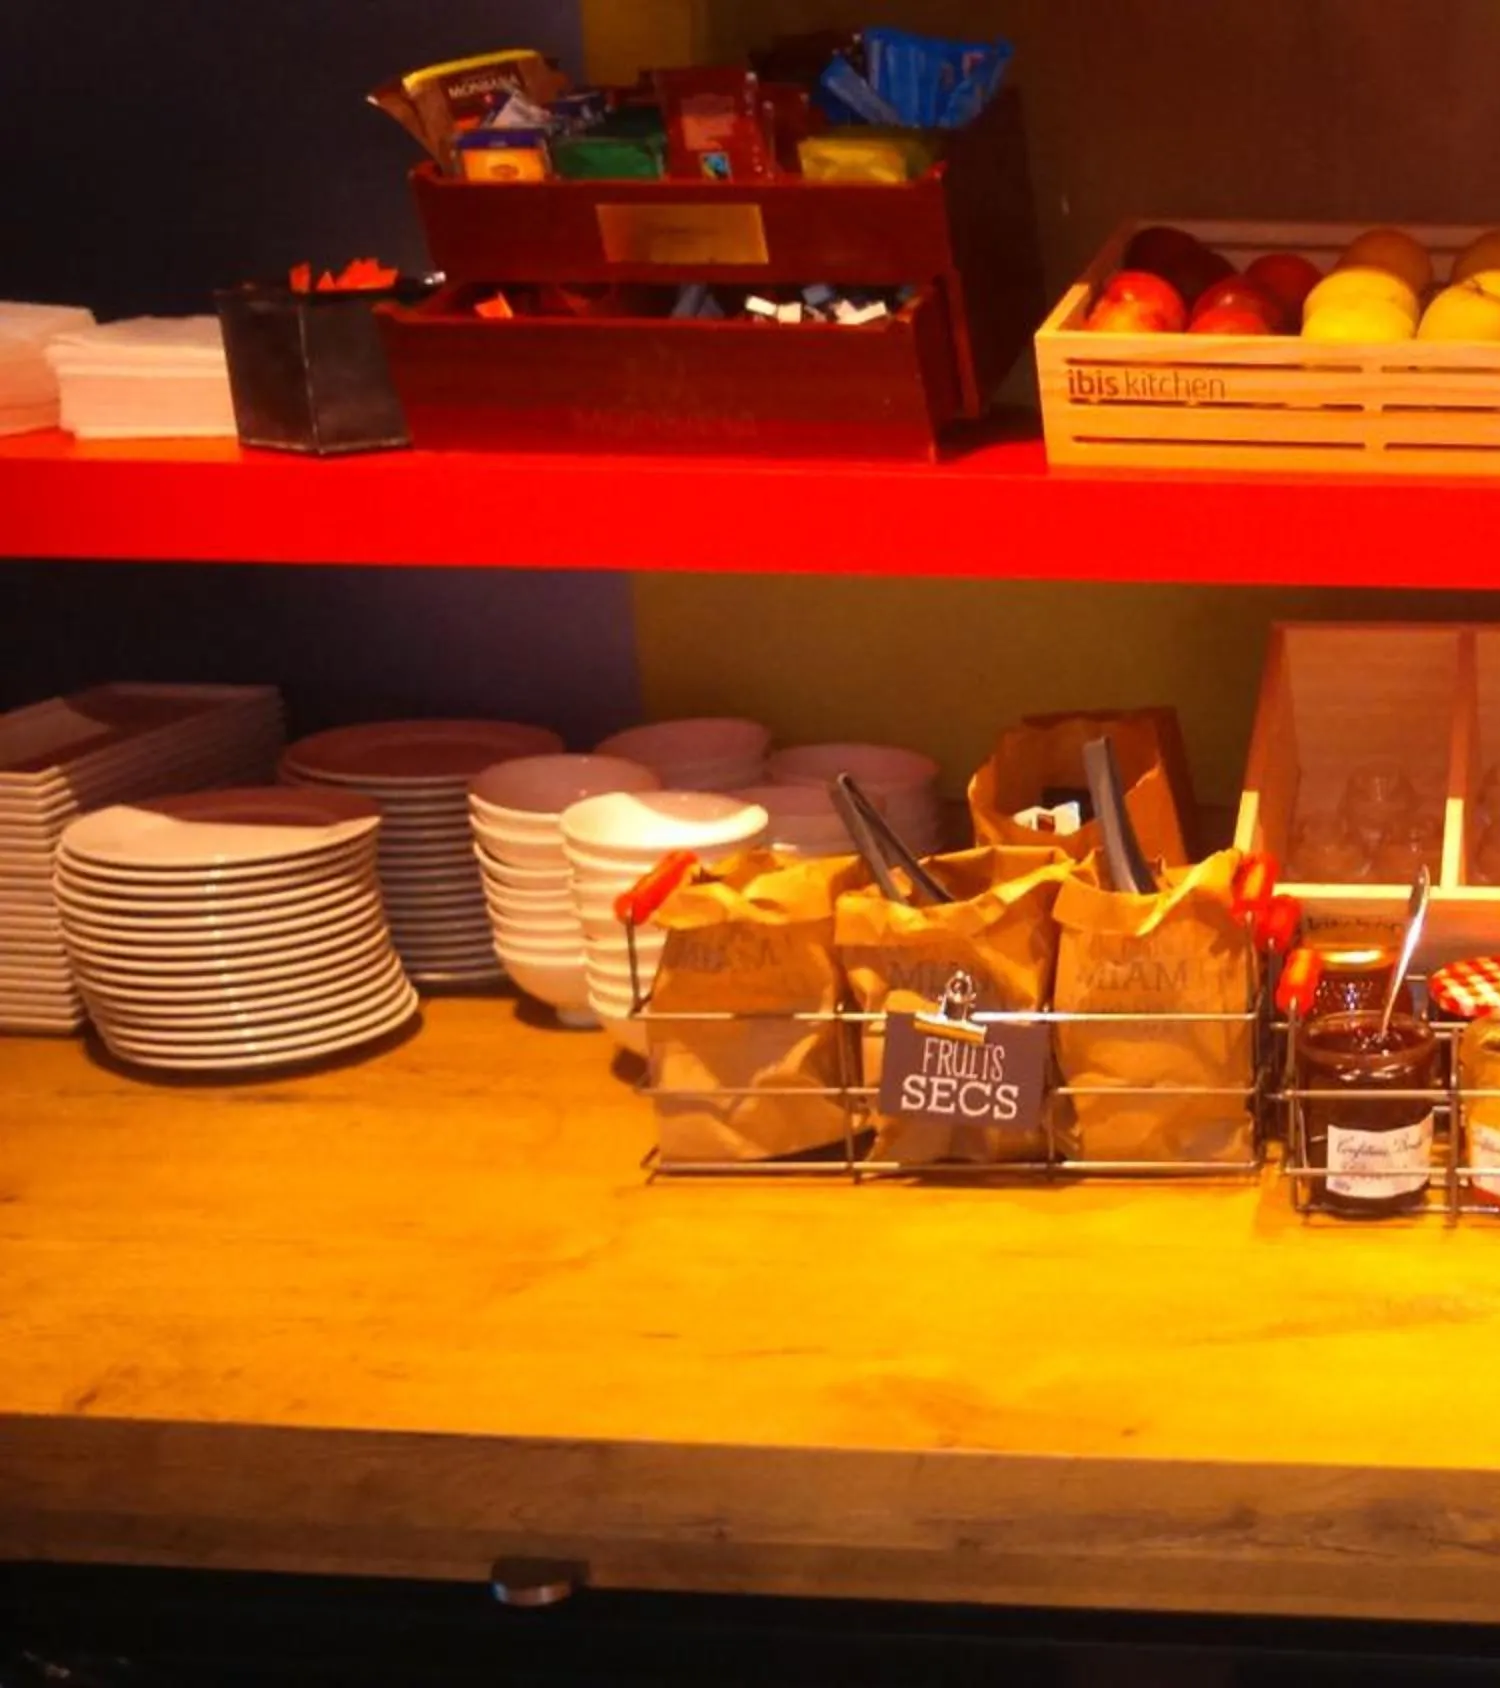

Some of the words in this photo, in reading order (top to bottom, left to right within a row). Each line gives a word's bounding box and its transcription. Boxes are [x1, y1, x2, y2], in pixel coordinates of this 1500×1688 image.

[1067, 369, 1119, 397] ibis
[1124, 369, 1226, 400] kitchen
[922, 1036, 1006, 1082] FRUITS
[901, 1073, 1020, 1120] SECS
